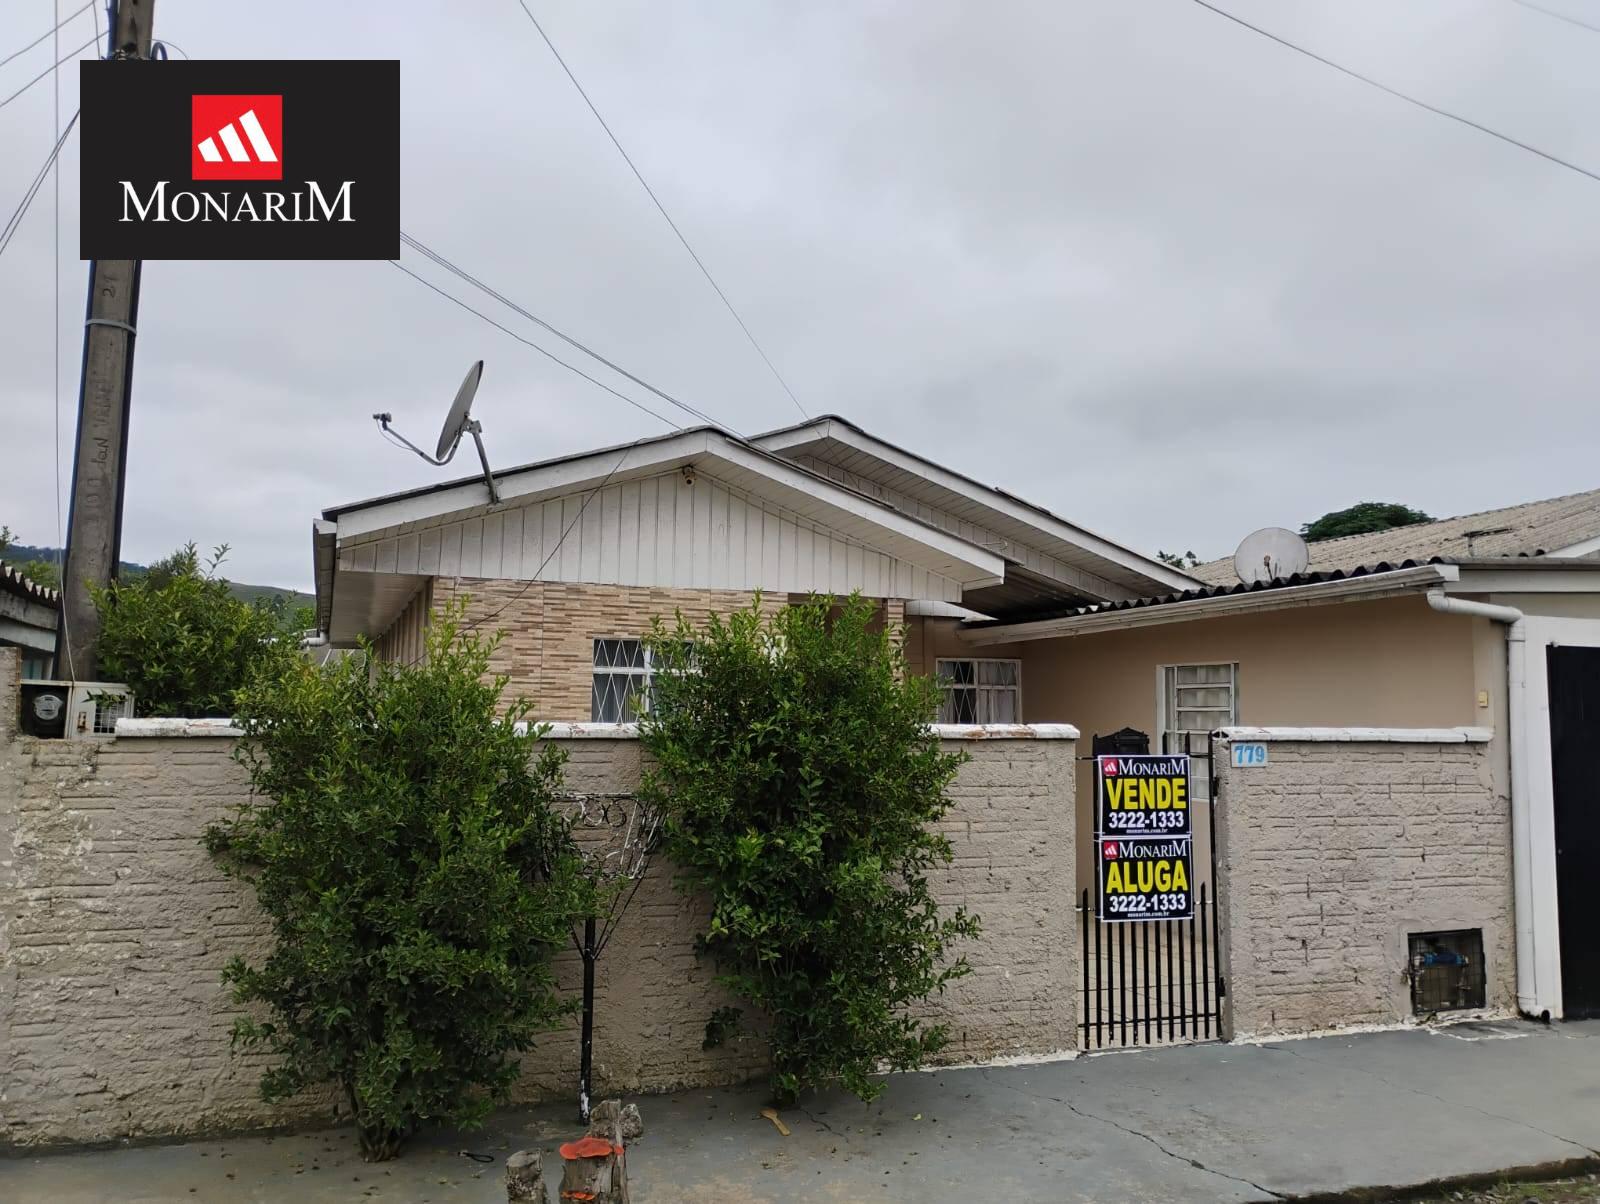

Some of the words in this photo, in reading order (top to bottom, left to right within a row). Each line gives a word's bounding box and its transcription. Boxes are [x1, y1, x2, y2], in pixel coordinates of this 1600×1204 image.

[1234, 745, 1265, 765] 779
[1118, 759, 1186, 775] MONARIM
[1105, 778, 1187, 810] VENDE
[1108, 811, 1185, 829] 3222-1333
[1119, 839, 1187, 859] MONARIM
[1106, 860, 1189, 894] ALUGA
[1109, 893, 1187, 913] 3222-1333
